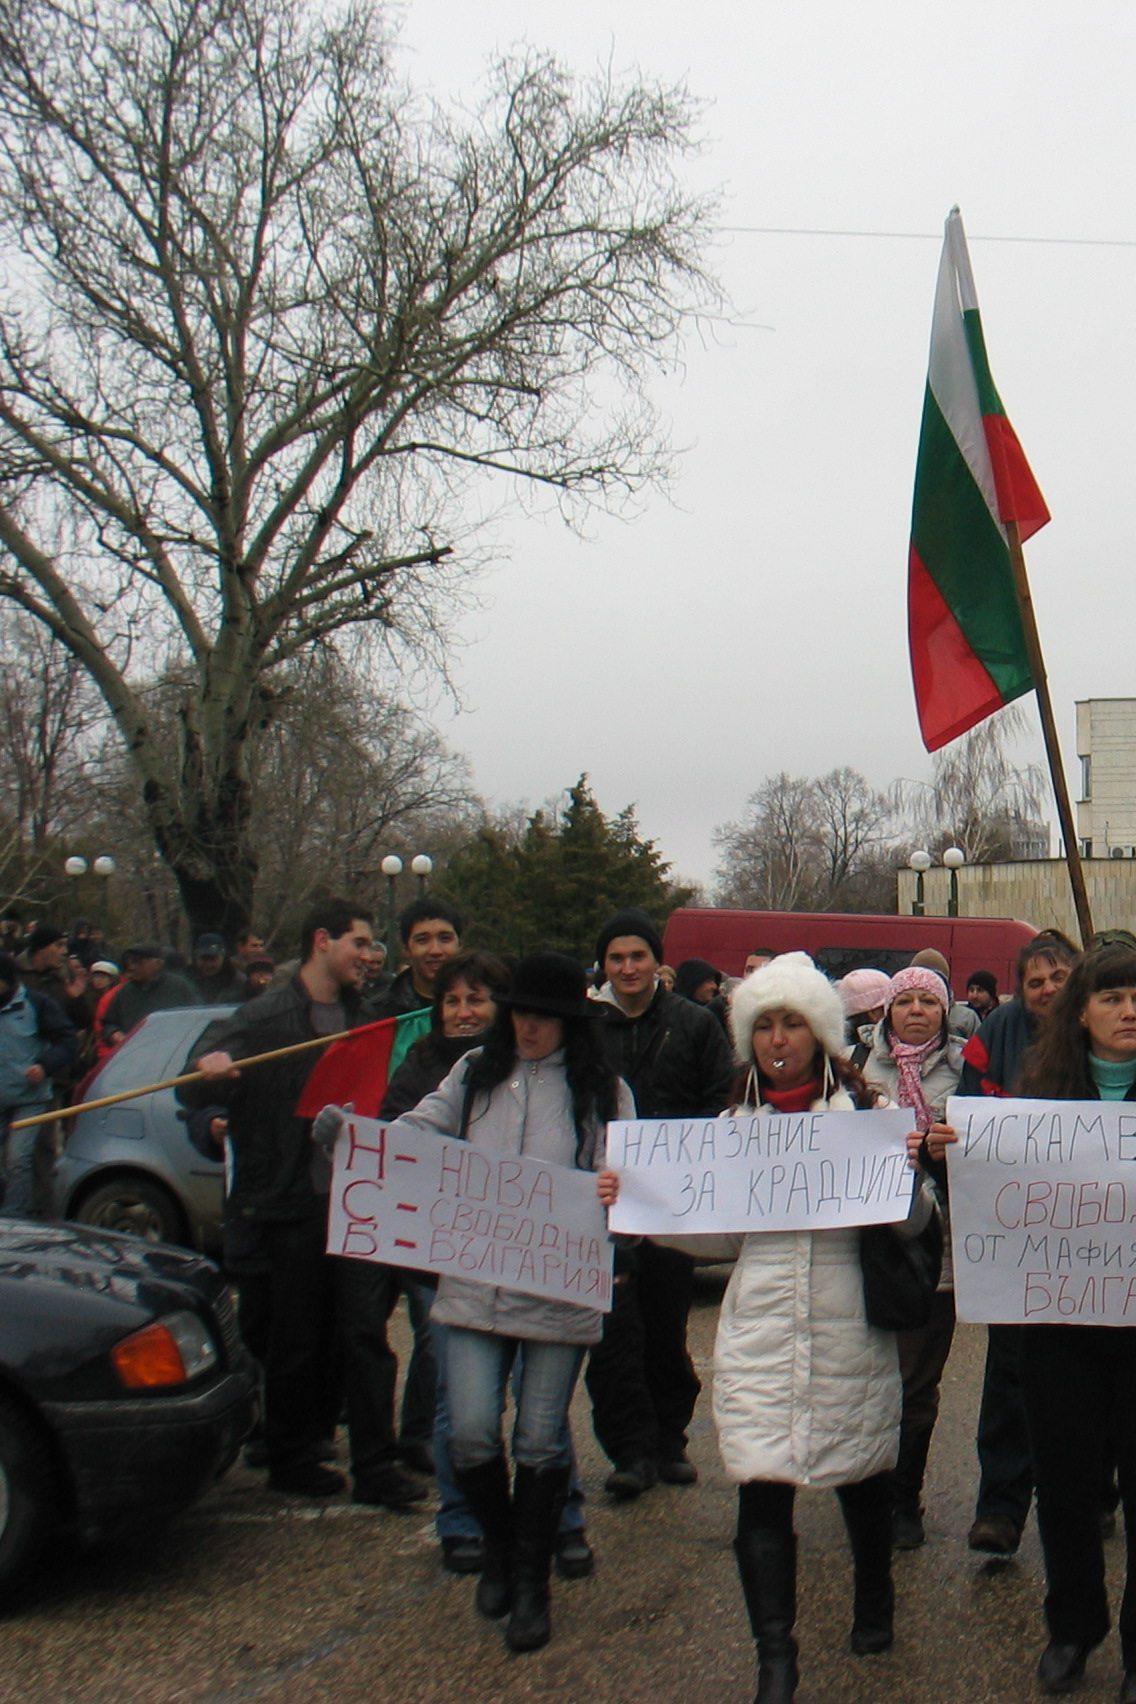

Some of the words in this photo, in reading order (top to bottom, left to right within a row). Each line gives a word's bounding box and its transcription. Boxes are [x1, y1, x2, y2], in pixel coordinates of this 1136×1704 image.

[623, 1114, 824, 1167] НАКАЗАНИЕ
[438, 1145, 553, 1214] НОВА
[673, 1170, 715, 1217] ЗА
[746, 1152, 913, 1217] КРАДЦИТЕ
[429, 1198, 601, 1265] СВОБОДНА
[964, 1233, 1005, 1263] ОТ
